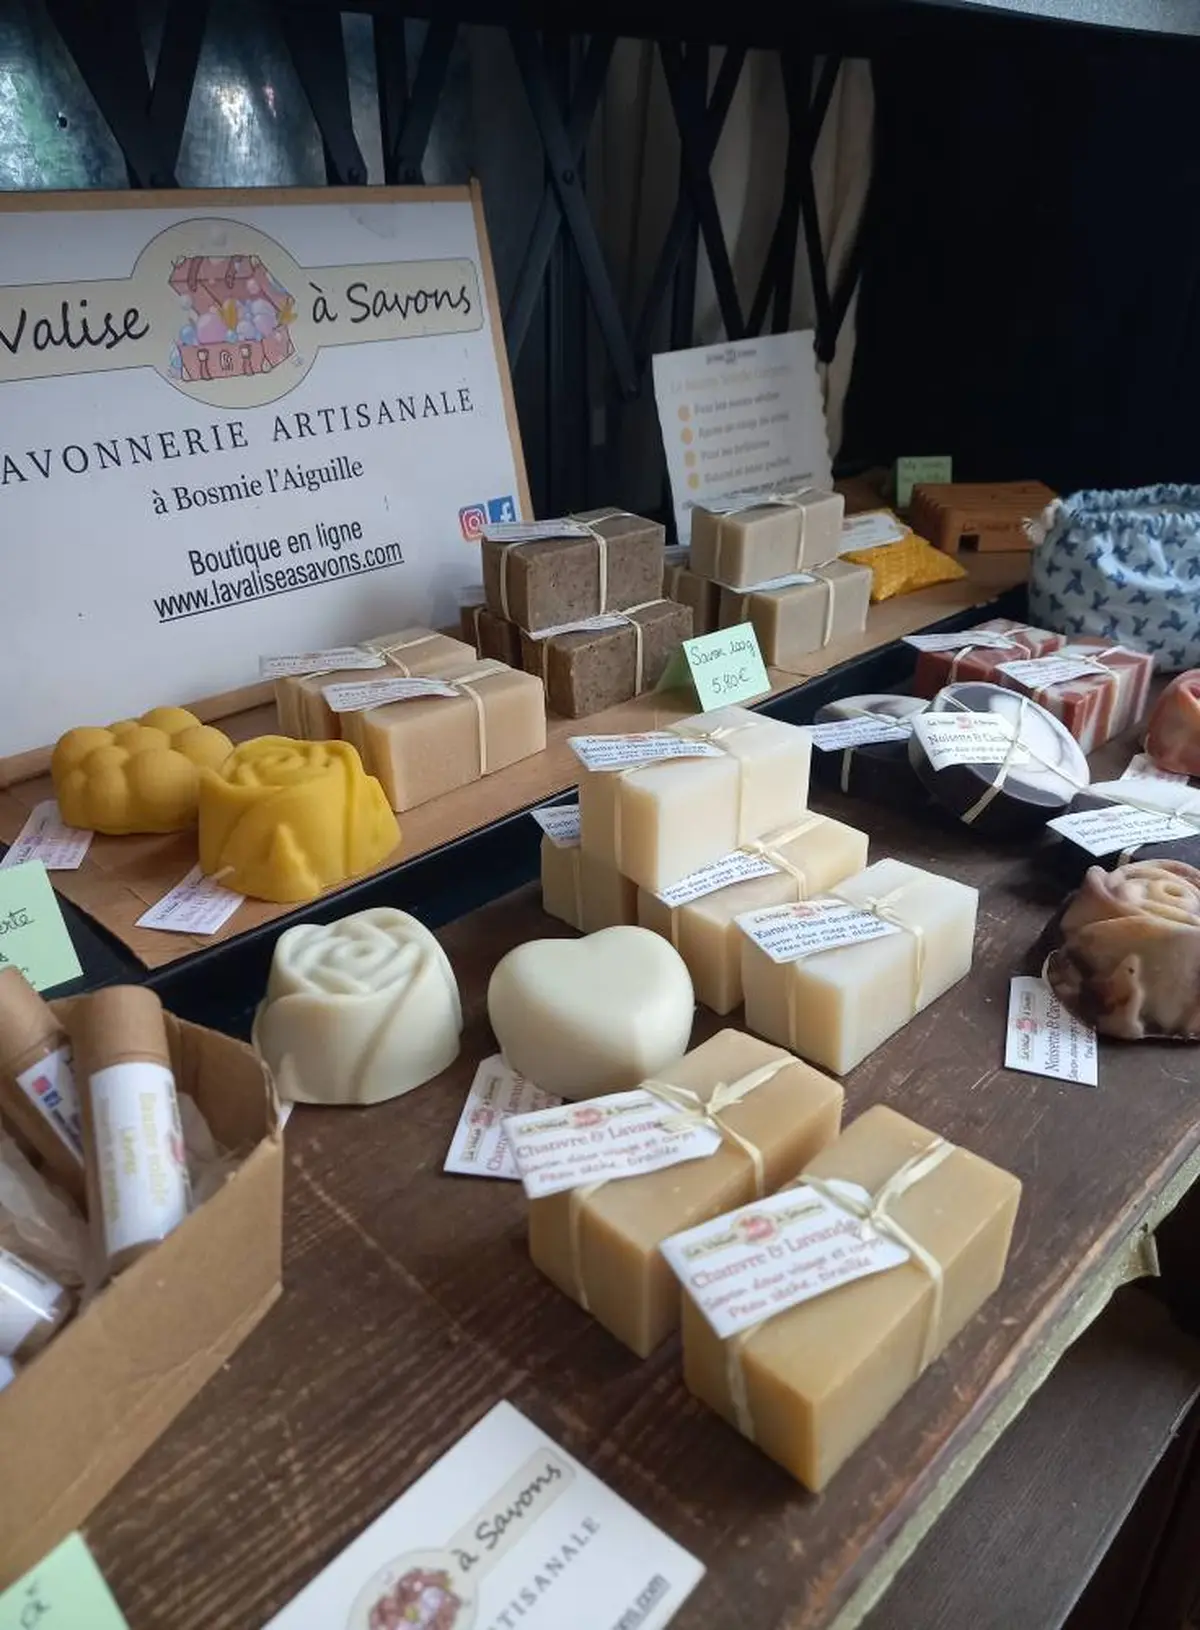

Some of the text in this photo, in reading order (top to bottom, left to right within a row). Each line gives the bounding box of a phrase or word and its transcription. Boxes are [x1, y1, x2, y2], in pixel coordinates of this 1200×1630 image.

[0, 281, 472, 354] Valise à Savons
[273, 388, 474, 443] ARTISANALE
[152, 455, 365, 515] à Bosmie l'Aiguille
[188, 520, 364, 576] Boutique en ligne
[153, 542, 405, 622] www.lavaliseasavons.com
[516, 1136, 588, 1160] Chanvre
[690, 1253, 768, 1289] Chanvre
[451, 1463, 562, 1572] à Savons
[486, 1516, 601, 1630] TISANALE
